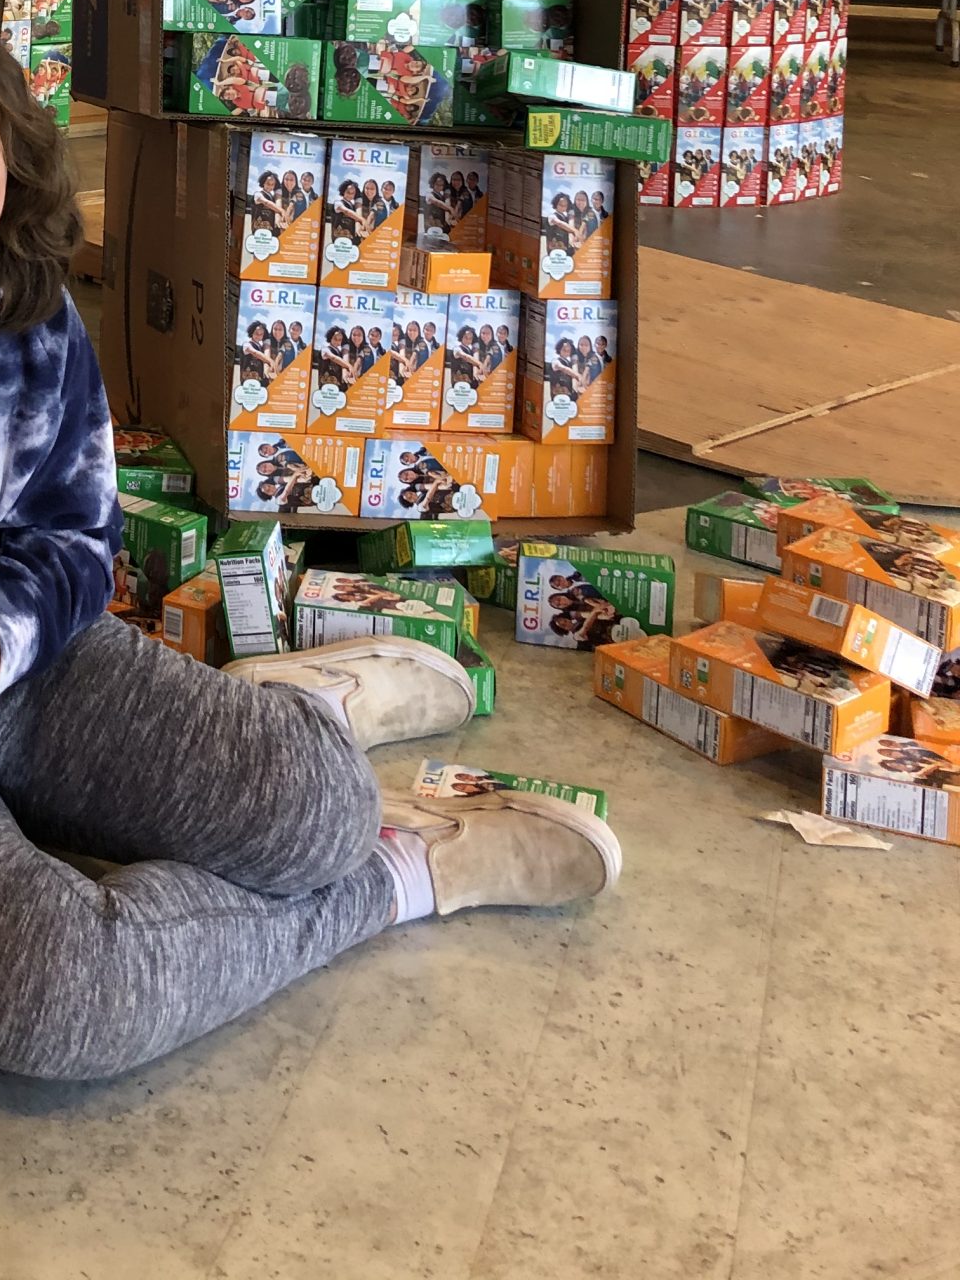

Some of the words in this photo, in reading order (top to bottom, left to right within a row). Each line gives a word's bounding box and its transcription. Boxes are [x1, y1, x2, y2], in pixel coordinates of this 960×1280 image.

[262, 139, 316, 156] G.I.R.L.
[342, 148, 397, 165] G.I.R.L.
[250, 289, 304, 305] G.I.R.L.
[329, 295, 383, 311] G.I.R.L.
[394, 291, 438, 306] .I.R.L.
